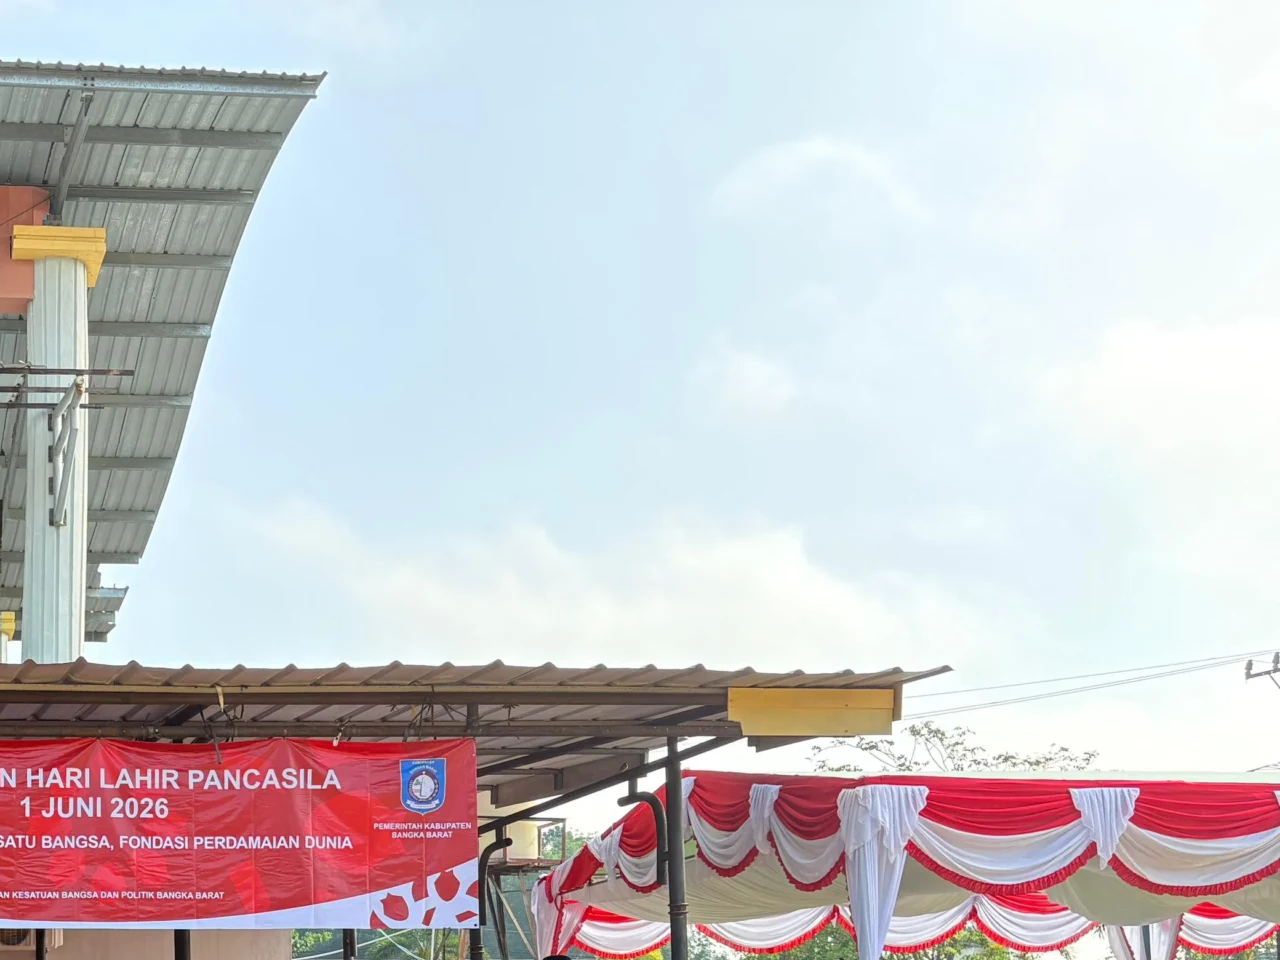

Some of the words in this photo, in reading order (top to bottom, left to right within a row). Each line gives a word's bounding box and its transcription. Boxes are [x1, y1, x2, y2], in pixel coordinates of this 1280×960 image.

[26, 767, 90, 789] HARI
[99, 767, 180, 790] LAHIR
[188, 767, 342, 790] PANCASILA
[20, 797, 31, 818] 1
[41, 797, 102, 819] JUNI
[110, 797, 169, 819] 2026
[373, 822, 423, 830] PEMERINTAH
[424, 822, 472, 830] KABUPATEN
[391, 831, 425, 839] BANGKA
[426, 831, 453, 839] BARAT
[41, 835, 114, 851] BANGSA,
[119, 835, 189, 850] FONDASI
[193, 835, 300, 850] PERDAMAIAN
[304, 835, 353, 850] DUNIA
[11, 891, 60, 899] KESATUAN
[61, 891, 99, 900] BANGSA
[100, 891, 119, 900] DAN
[121, 891, 155, 900] POLITIK
[156, 891, 195, 900] BANGKA
[196, 891, 225, 900] BARAT
